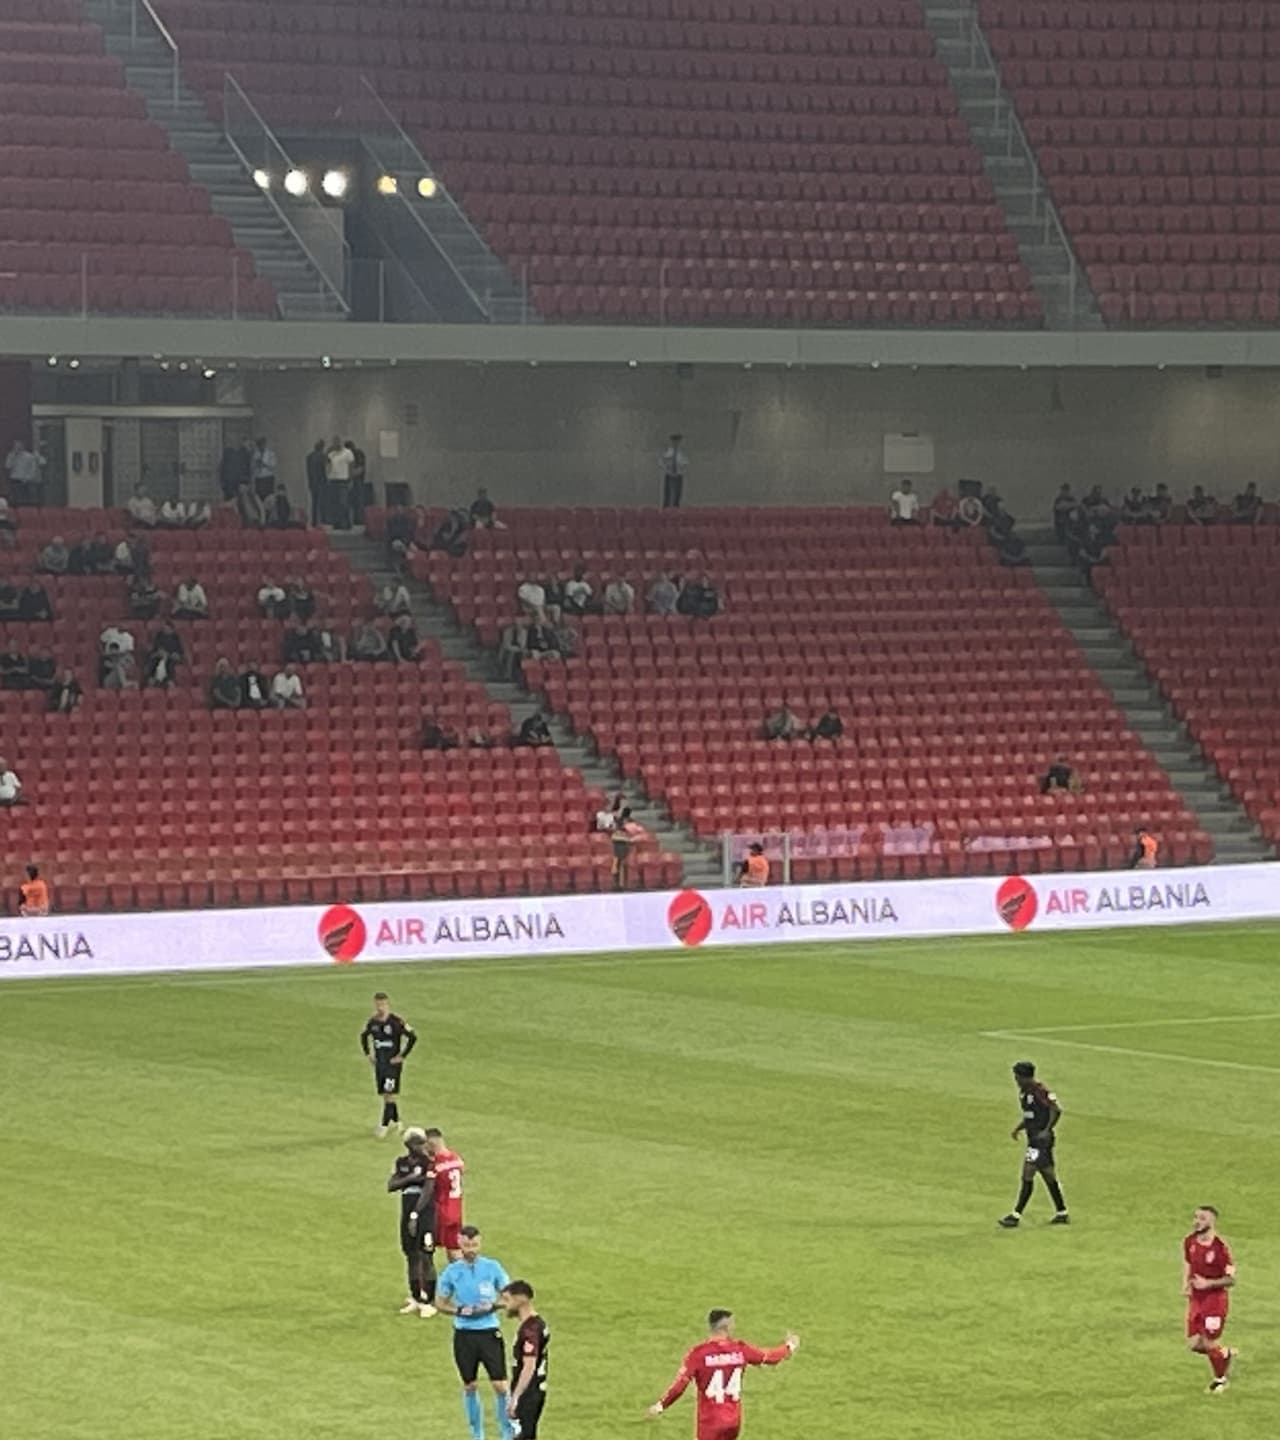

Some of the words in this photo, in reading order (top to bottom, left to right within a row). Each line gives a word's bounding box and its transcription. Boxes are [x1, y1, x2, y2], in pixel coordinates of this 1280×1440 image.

[720, 903, 768, 930] AIR
[775, 898, 899, 928] ALBANIA
[1045, 888, 1090, 915] AIR
[1096, 882, 1211, 912] ALBANIA
[375, 918, 426, 946] AIR
[433, 912, 565, 944] ALBANIA
[705, 1367, 742, 1404] 44
